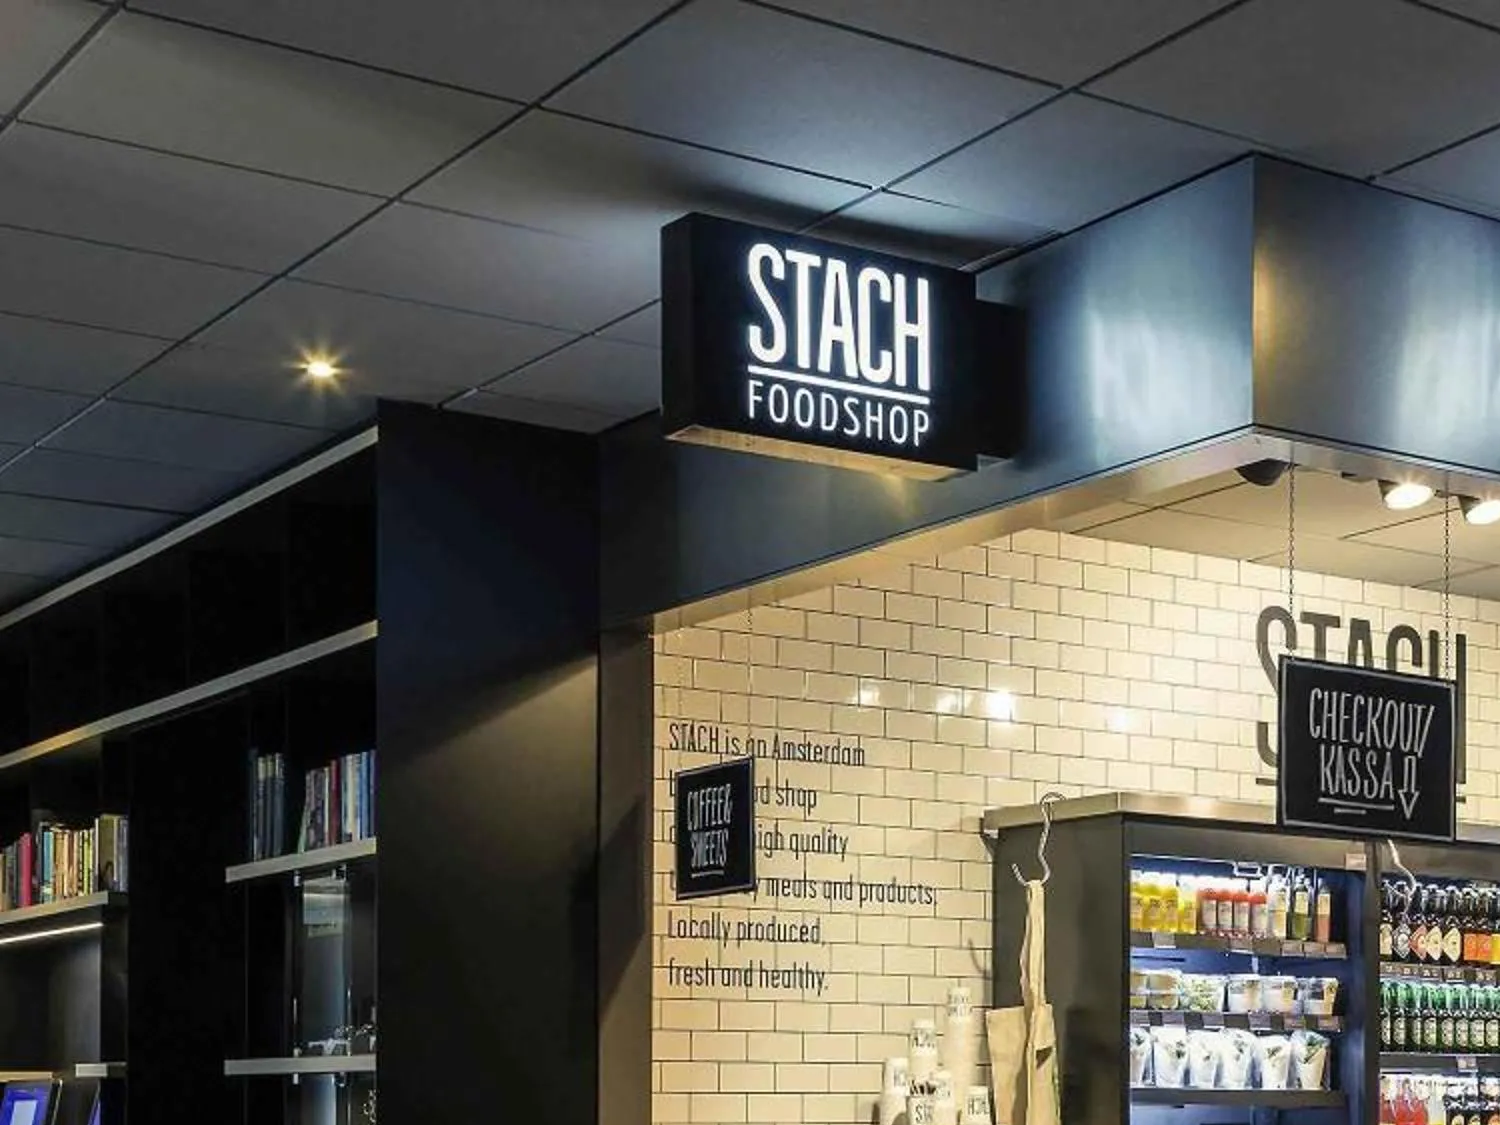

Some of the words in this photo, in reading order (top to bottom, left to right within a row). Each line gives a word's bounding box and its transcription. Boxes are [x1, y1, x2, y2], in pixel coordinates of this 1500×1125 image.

[747, 242, 931, 391] STACH
[748, 379, 931, 447] FOODSHOP
[669, 721, 719, 755] STACH
[725, 729, 741, 756] is
[746, 738, 767, 758] an
[772, 732, 866, 767] Amsterdam
[1320, 743, 1395, 800] KASSA
[776, 778, 817, 816] shop
[690, 828, 729, 868] SWEETS
[789, 826, 849, 862] quality
[766, 871, 817, 900] meals
[823, 872, 853, 901] and
[668, 909, 731, 949] Locally
[668, 956, 716, 987] fresh
[721, 959, 753, 988] and
